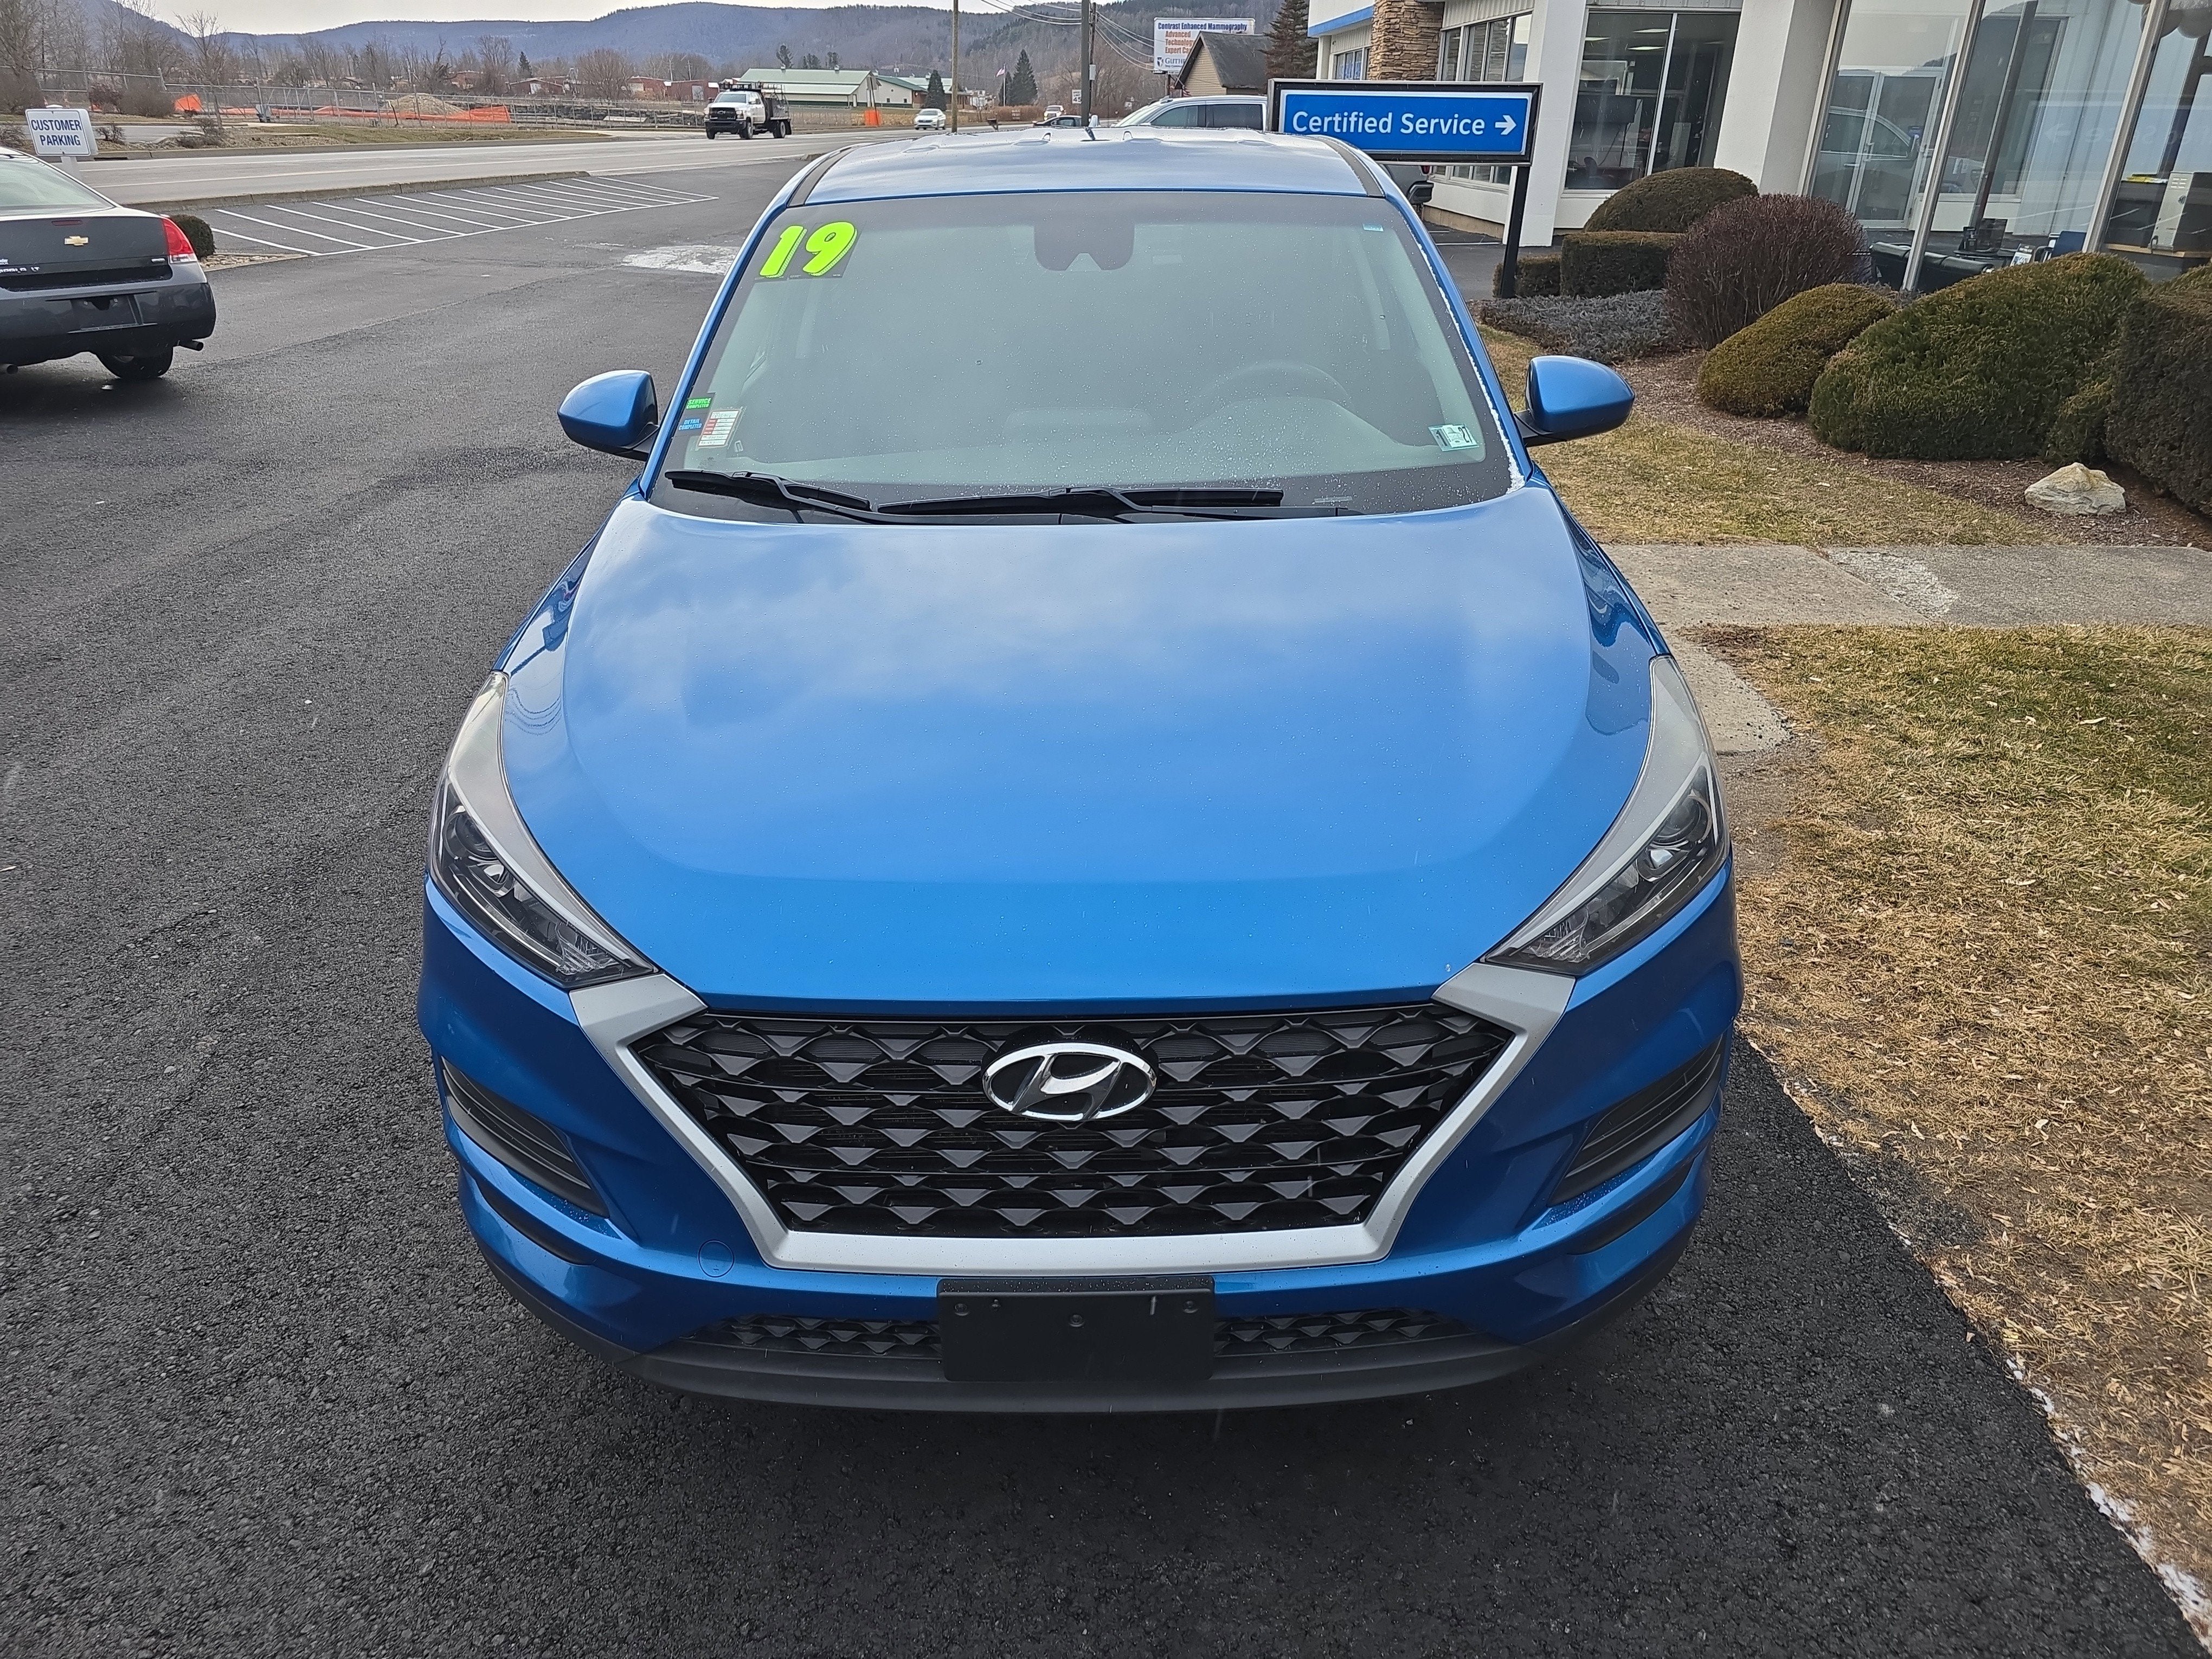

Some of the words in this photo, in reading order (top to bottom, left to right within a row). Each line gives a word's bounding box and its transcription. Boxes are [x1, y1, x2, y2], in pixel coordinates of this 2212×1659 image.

[1208, 23, 1247, 31] Mammography
[31, 119, 82, 131] CUSTOMER
[1292, 111, 1392, 133] Certified
[1400, 113, 1485, 135] Service
[40, 134, 81, 146] PARKING
[760, 221, 858, 279] 19
